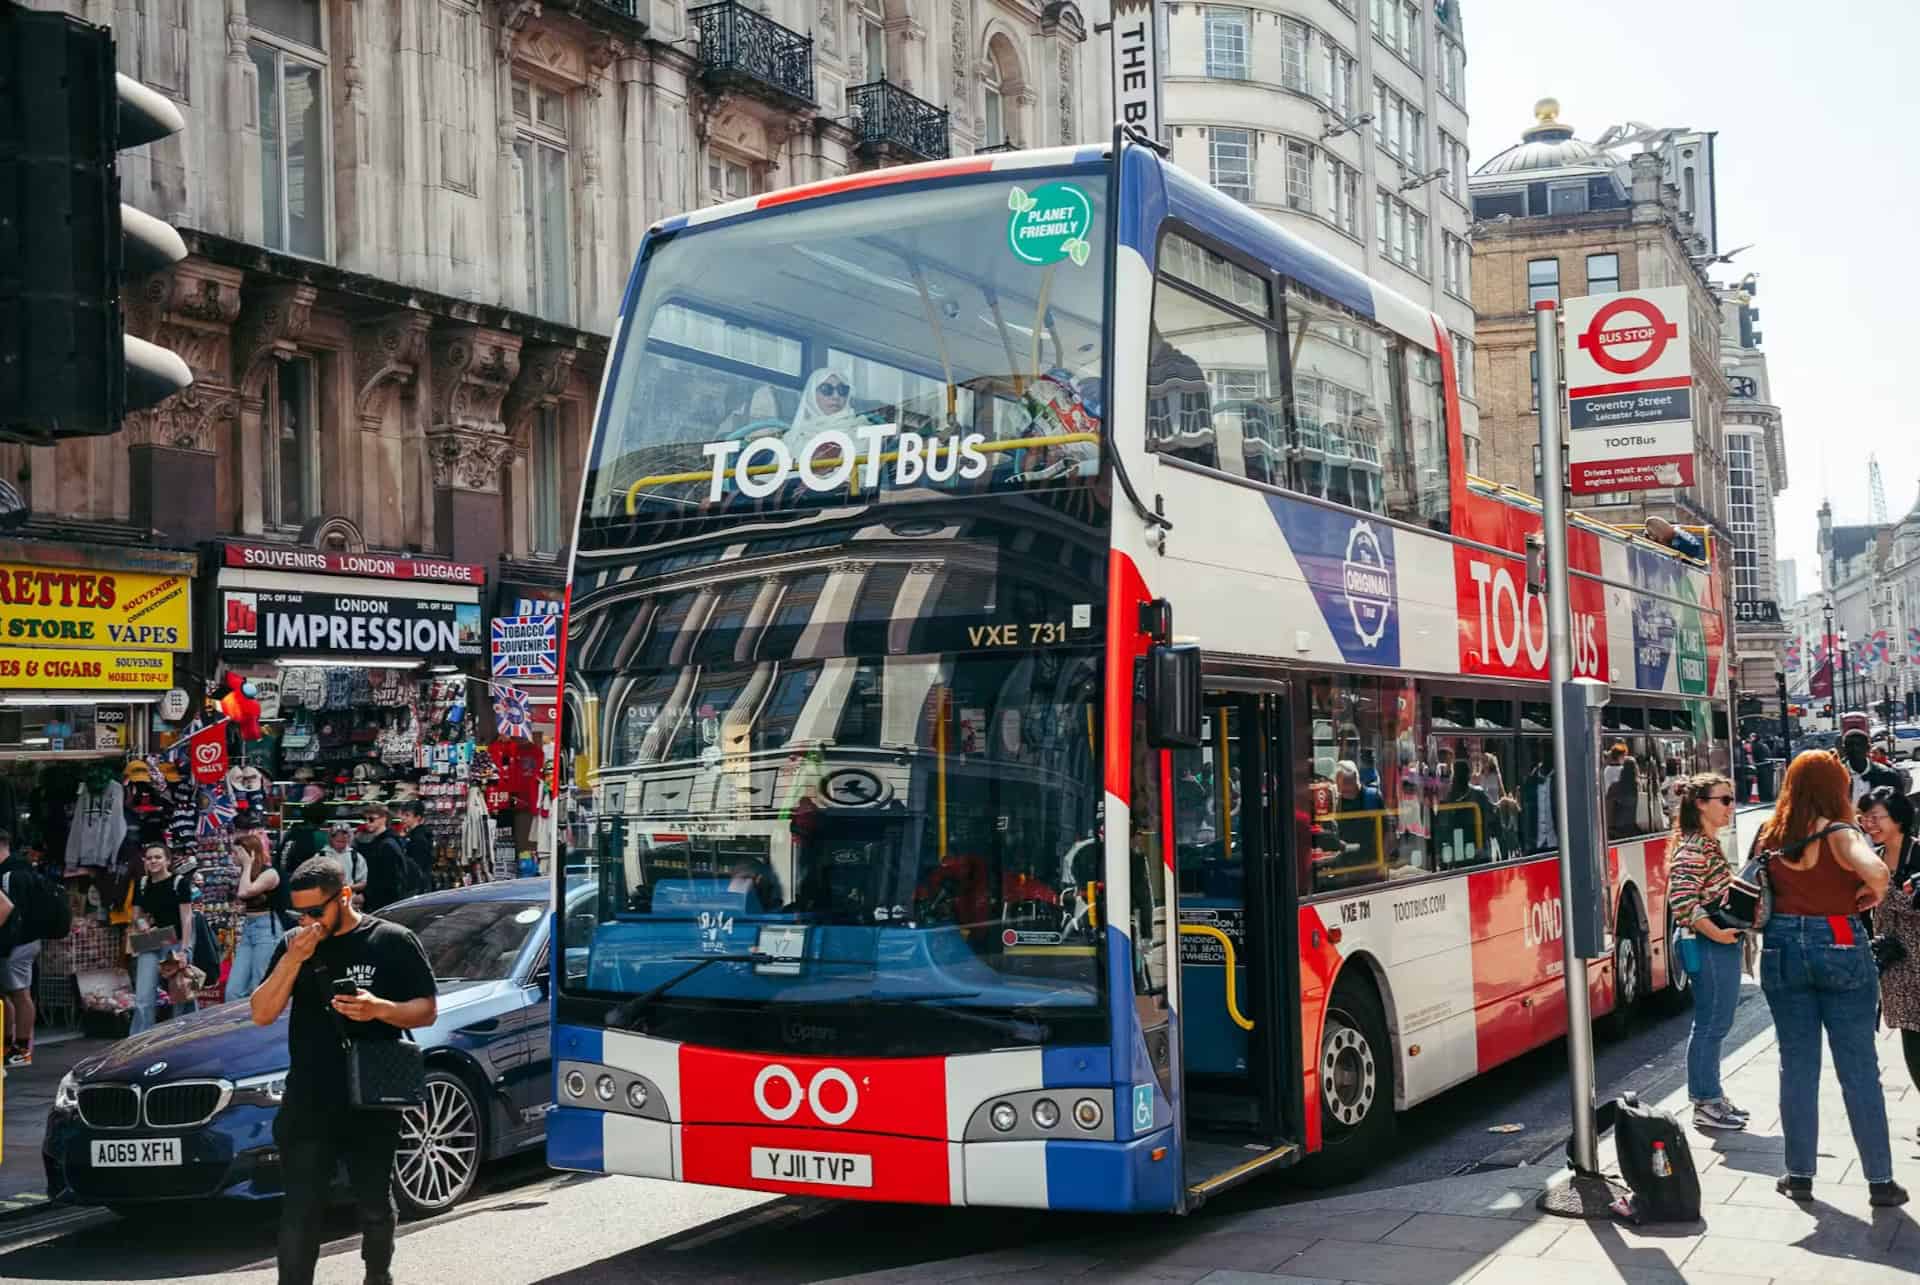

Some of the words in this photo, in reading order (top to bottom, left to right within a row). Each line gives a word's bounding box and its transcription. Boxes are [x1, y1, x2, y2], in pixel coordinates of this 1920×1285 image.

[1121, 21, 1146, 92] THE
[1027, 206, 1076, 223] PLANET
[1019, 221, 1079, 239] FRIENDLY
[1598, 330, 1623, 344] BUS
[1623, 327, 1656, 342] STOP
[1585, 398, 1635, 412] Coventry
[1637, 395, 1672, 407] Street
[1595, 411, 1632, 422] Leicester
[1634, 409, 1663, 419] Square
[1614, 466, 1635, 475] must
[244, 549, 328, 569] SOUVENIRS
[340, 556, 396, 575] LONDON
[413, 562, 472, 581] LUGGAGE
[1346, 569, 1389, 597] ORIGINAL
[121, 575, 180, 613] SOUVENIRS
[275, 594, 287, 602] OFF
[287, 595, 303, 603] SALE
[335, 598, 389, 614] LONDON
[1470, 559, 1599, 676] TOOUS
[8, 617, 96, 640] STORE
[108, 624, 179, 644] VAPES
[265, 612, 462, 654] IMPRESSION
[502, 624, 545, 639] TOBACCO
[967, 623, 1019, 647] VXE
[1029, 621, 1066, 644] 731
[223, 639, 258, 650] LUGGAGE
[499, 638, 549, 654] SOUVENIRS
[25, 660, 39, 677] &
[43, 661, 102, 678] CIGARS
[115, 657, 163, 668] SOUVENIRS
[507, 653, 541, 667] MOBILE
[108, 671, 139, 683] MOBILE
[140, 671, 169, 683] TOP-UP
[1340, 900, 1358, 924] VXE
[1393, 893, 1446, 922] TOOTBUS.COM
[1523, 897, 1563, 949] LOND
[346, 964, 377, 977] AMIRI
[141, 1141, 175, 1162] XFH
[768, 1151, 807, 1179] YJ11
[812, 1156, 856, 1183] TVP
